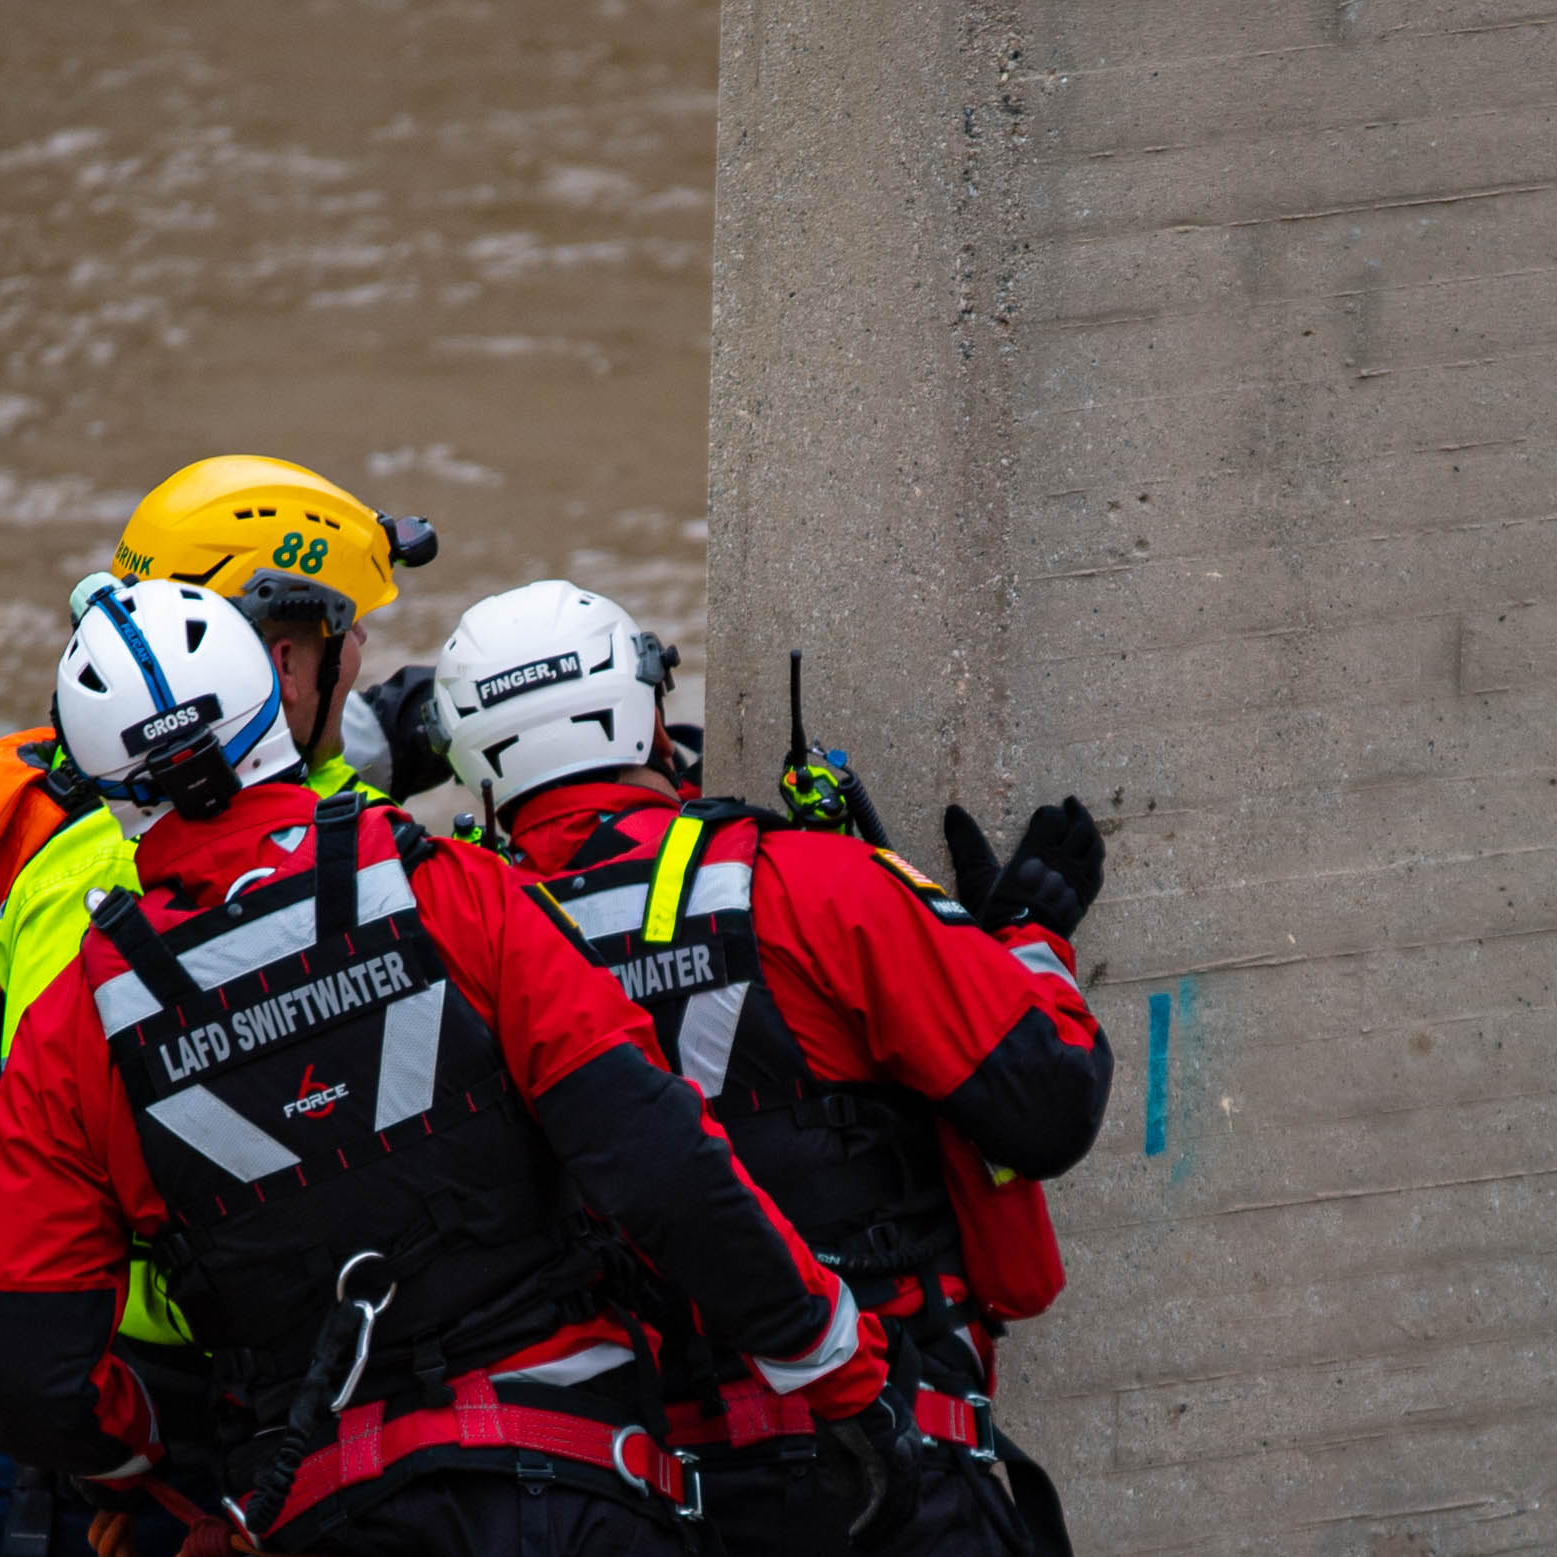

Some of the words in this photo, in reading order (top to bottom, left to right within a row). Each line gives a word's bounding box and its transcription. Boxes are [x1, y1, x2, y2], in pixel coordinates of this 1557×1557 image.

[273, 532, 328, 574] 88
[480, 663, 557, 699] FINGER,
[559, 657, 577, 672] M
[143, 706, 200, 740] GROSS
[159, 1022, 231, 1082] LAFD
[232, 951, 413, 1052] SWIFTWATER
[283, 1083, 349, 1118] FORCE
